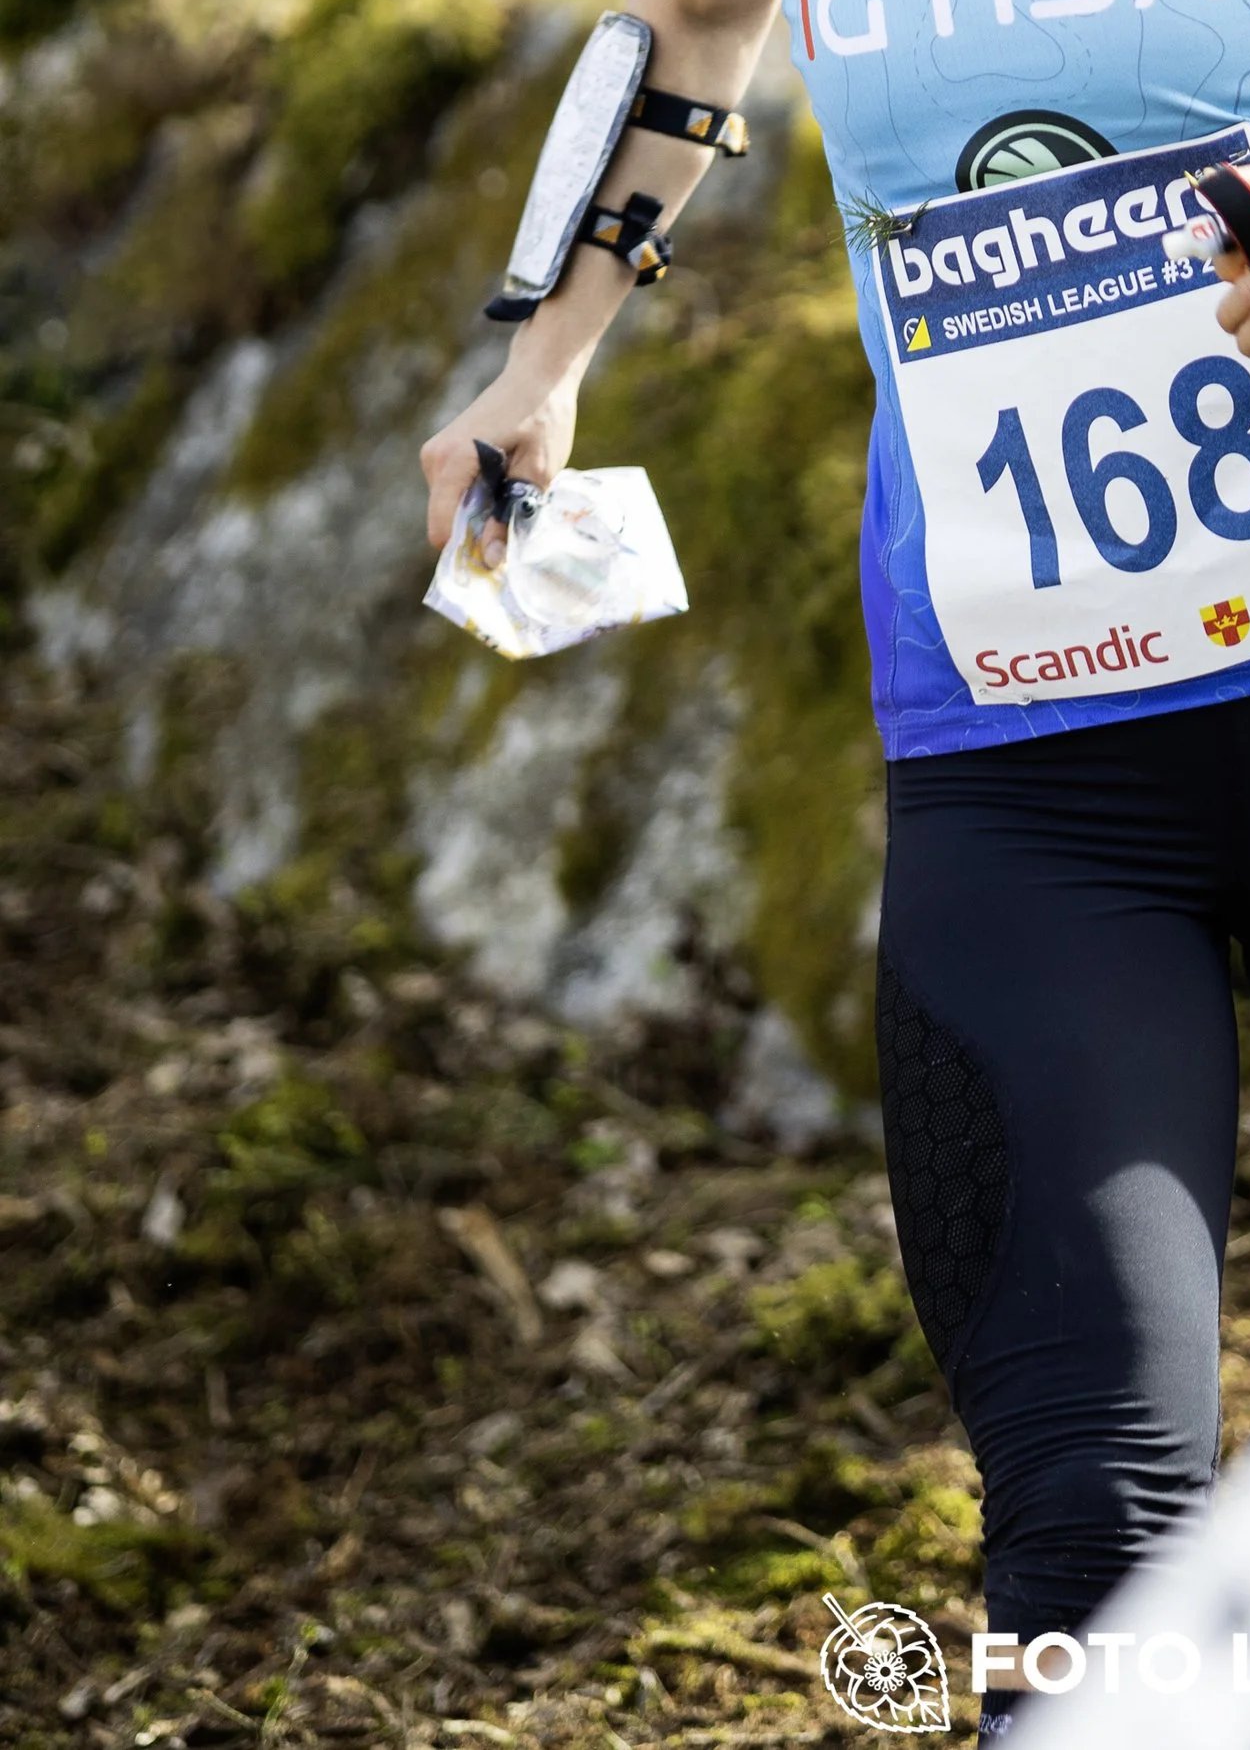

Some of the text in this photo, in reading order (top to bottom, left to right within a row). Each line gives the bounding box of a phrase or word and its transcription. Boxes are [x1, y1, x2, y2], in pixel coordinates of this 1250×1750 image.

[943, 256, 1194, 340] SWEDISH LEAGUE #3
[975, 624, 1170, 688] Scandic
